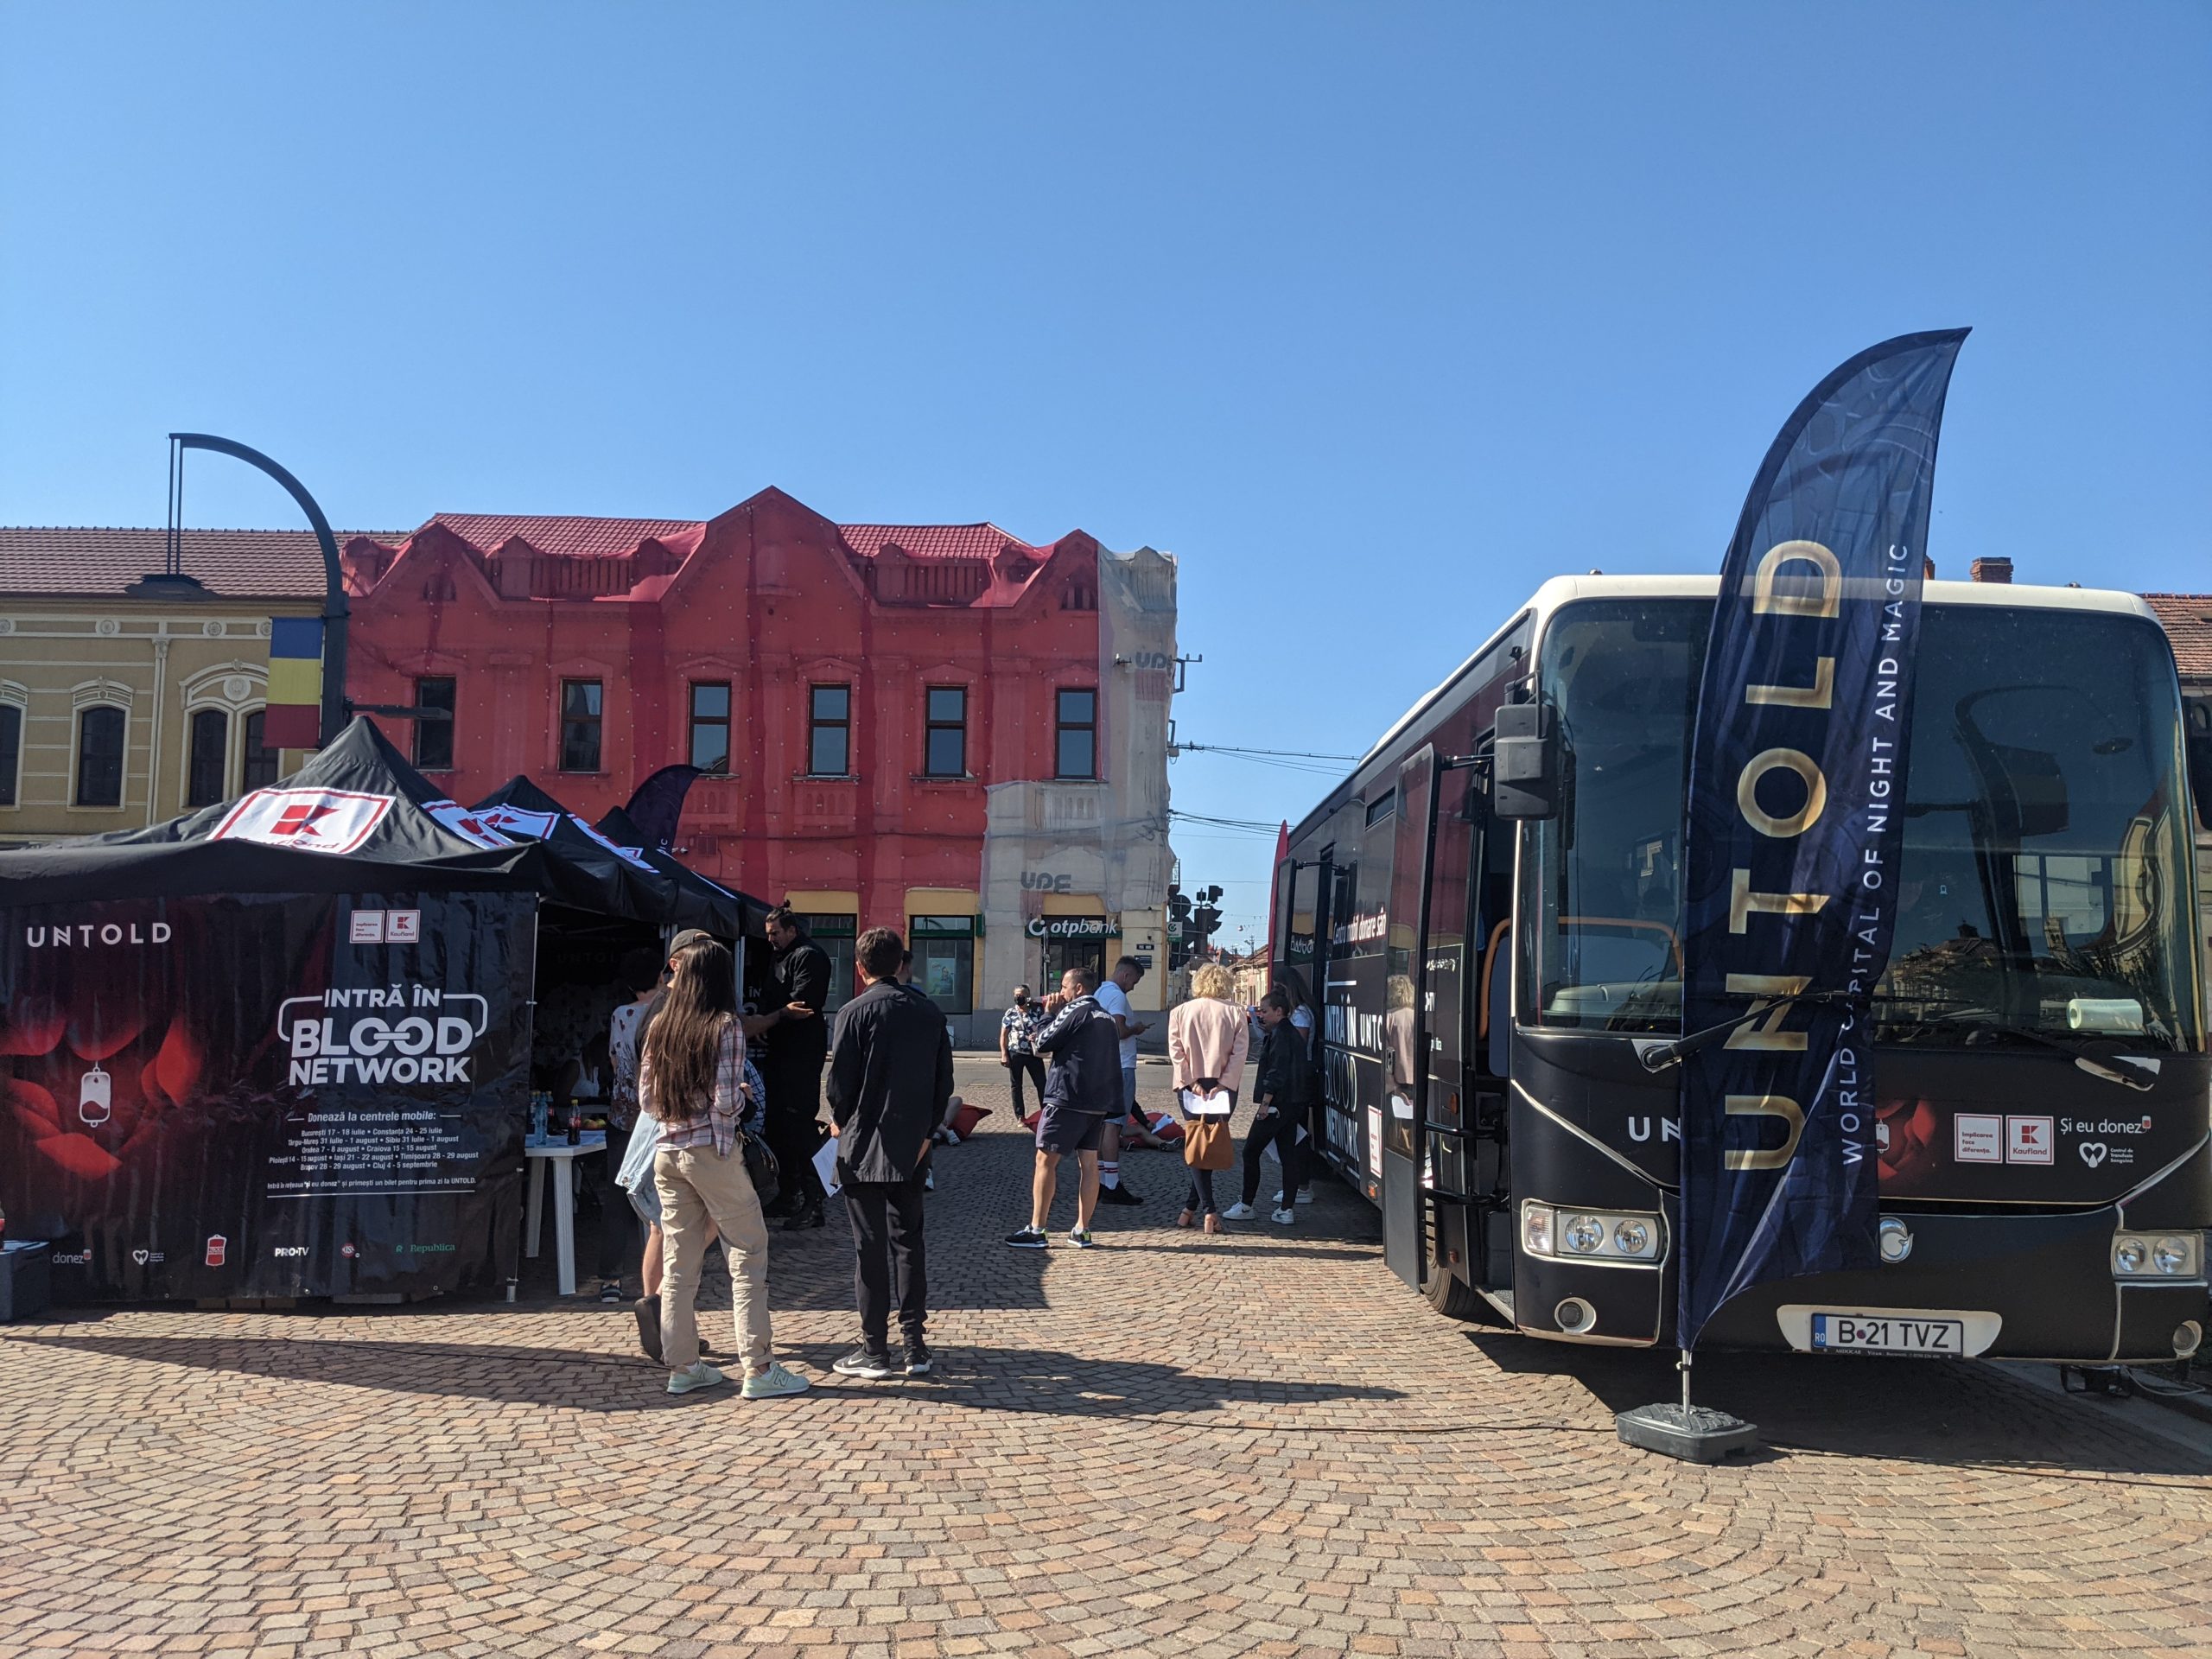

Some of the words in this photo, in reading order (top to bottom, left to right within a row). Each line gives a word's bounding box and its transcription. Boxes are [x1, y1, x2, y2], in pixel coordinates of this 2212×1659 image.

[1881, 544, 1908, 641] MAGIC
[1875, 658, 1898, 721] AND
[1866, 737, 1892, 832] NIGHT
[1723, 540, 1841, 1170] UNTOLD
[1863, 849, 1884, 889] OF
[27, 922, 171, 948] UNTOLD
[1359, 912, 1376, 941] donare
[324, 983, 405, 1007] INTRĂ
[412, 983, 440, 1007] ÎN
[291, 1017, 474, 1058] BLOOD
[1347, 993, 1357, 1048] ÎN
[289, 1056, 471, 1086] NETWORK
[1325, 1048, 1357, 1113] BLOOD
[308, 1111, 345, 1122] Donează
[348, 1112, 357, 1122] la
[359, 1112, 399, 1122] centrele
[401, 1111, 436, 1121] mobile:
[1840, 1047, 1863, 1165] WORLD
[1325, 1105, 1360, 1162] NETWORK
[2060, 1118, 2072, 1135] Și
[2075, 1122, 2094, 1133] eu
[2098, 1119, 2142, 1134] donez
[52, 1251, 85, 1264] donez
[410, 1243, 455, 1254] Republica
[1815, 1333, 1826, 1343] RO
[1899, 1323, 1949, 1348] TVZ
